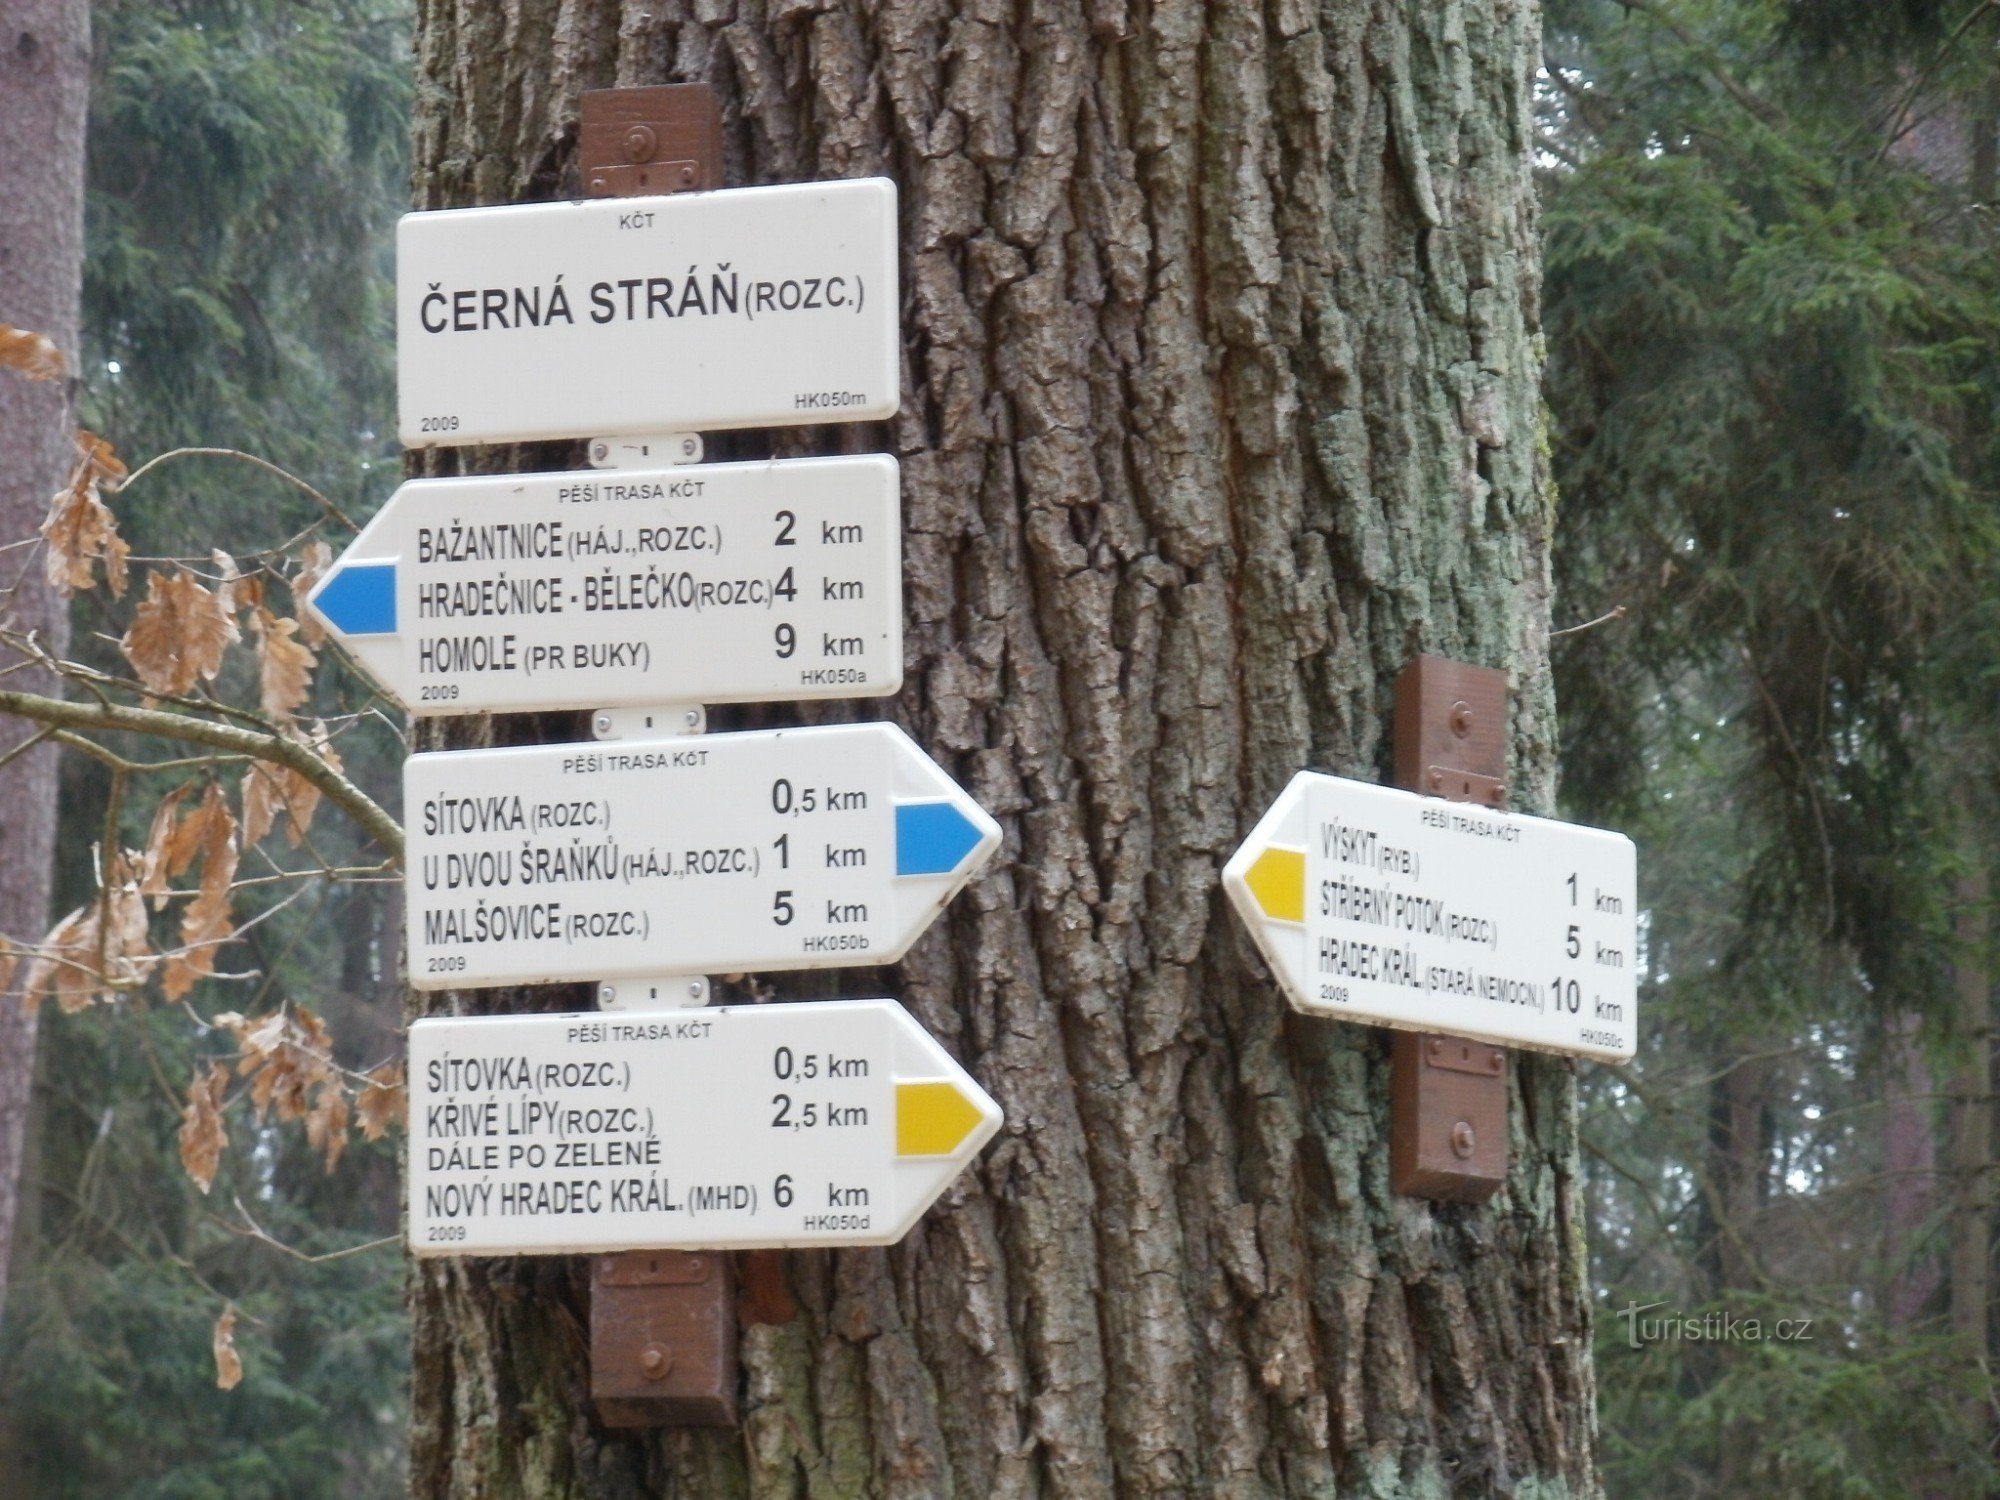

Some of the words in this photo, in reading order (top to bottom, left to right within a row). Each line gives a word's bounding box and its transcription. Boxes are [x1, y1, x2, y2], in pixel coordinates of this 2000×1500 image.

[619, 210, 656, 231] KČT
[420, 273, 574, 334] ČERNÁ
[794, 390, 867, 410] HK050m
[420, 415, 460, 433] 2009
[558, 483, 600, 504] PĚŠÍ
[603, 482, 667, 502] TRASA
[669, 480, 706, 500] KČT
[773, 510, 797, 547] 2
[821, 519, 864, 544] km
[418, 570, 564, 618] HRADEČNICE
[773, 566, 798, 603] 4
[822, 575, 864, 601] km
[419, 634, 517, 674] HOMOLE
[523, 644, 564, 677] (PR
[573, 641, 650, 673] BUKY)
[774, 622, 797, 659] 9
[822, 631, 865, 657] km
[420, 683, 460, 701] 2009
[800, 667, 867, 686] HK050a
[562, 753, 604, 775] PĚŠÍ
[607, 753, 670, 772] TRASA
[672, 749, 709, 770] KČT
[771, 778, 817, 819] 0,5
[826, 786, 868, 812] km
[1452, 816, 1497, 838] TRASA
[1496, 823, 1522, 844] KČT
[423, 854, 440, 891] U
[446, 849, 513, 889] DVOU
[772, 833, 790, 870] 1
[825, 843, 867, 869] km
[772, 889, 794, 927] 5
[826, 899, 868, 925] km
[1565, 871, 1580, 907] 1
[1594, 886, 1623, 915] km
[1321, 874, 1392, 927] STŘÍBRNÝ
[1565, 924, 1581, 960] 5
[1595, 941, 1623, 969] km
[802, 933, 870, 953] HK050b
[427, 954, 467, 973] 2009
[1318, 935, 1379, 982] HRADEC
[1550, 975, 1581, 1015] 10
[1594, 995, 1623, 1023] km
[1319, 983, 1350, 1003] 2009
[566, 1024, 608, 1045] PĚŠÍ
[611, 1023, 672, 1043] TRASA
[675, 1020, 713, 1041] KČT
[773, 1046, 820, 1083] 0,5
[827, 1053, 870, 1079] km
[426, 1096, 499, 1139] KŘIVÉ
[771, 1093, 818, 1131] 2,5
[827, 1101, 869, 1127] km
[427, 1137, 499, 1172] DÁLE
[508, 1145, 544, 1169] PO
[554, 1133, 661, 1168] ZELENÉ
[426, 1175, 494, 1219] NOVÝ
[500, 1178, 603, 1215] HRADEC
[772, 1174, 794, 1208] 6
[827, 1181, 870, 1207] km
[427, 1223, 467, 1242] 2009
[803, 1213, 871, 1232] HK050d
